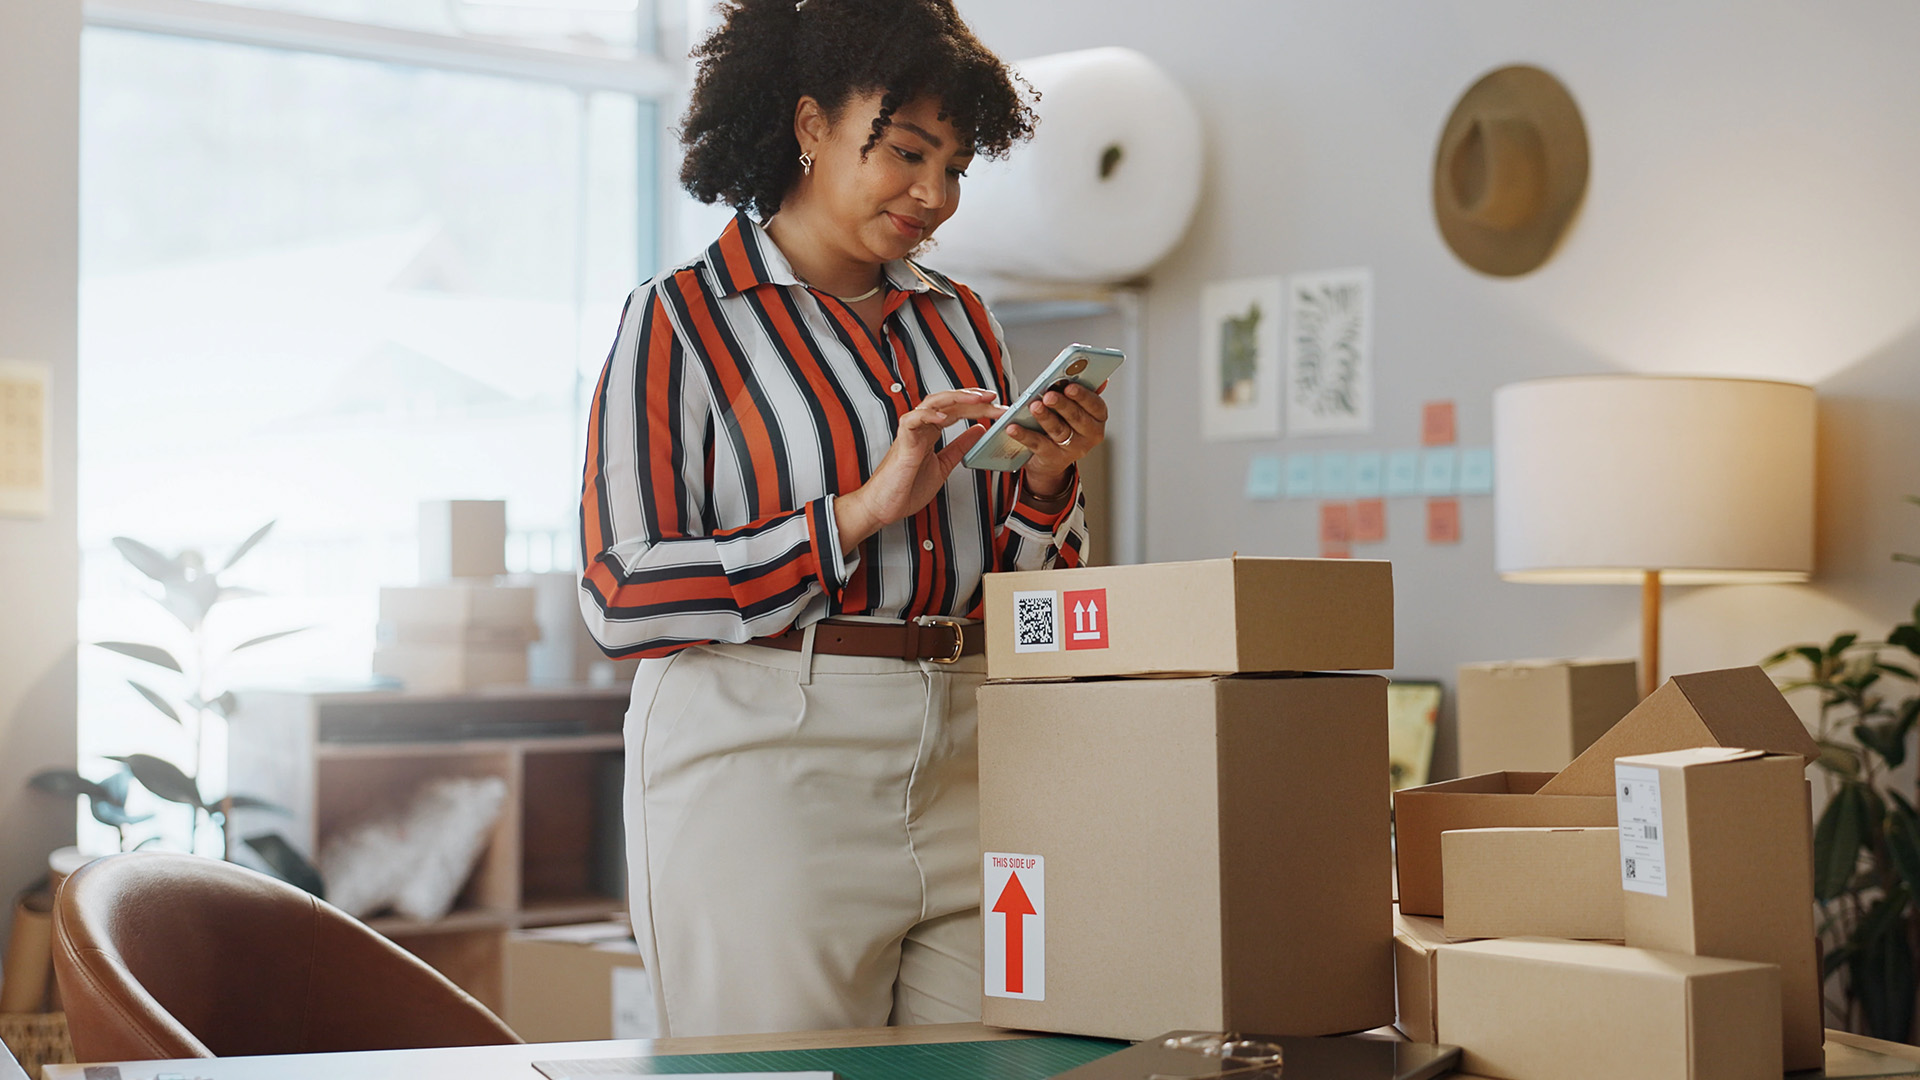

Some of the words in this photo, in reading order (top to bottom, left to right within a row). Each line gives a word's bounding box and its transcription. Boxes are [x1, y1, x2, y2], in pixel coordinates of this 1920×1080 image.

[992, 857, 1008, 868] THIS
[1009, 857, 1025, 869] SIDE
[1026, 858, 1036, 869] UP
